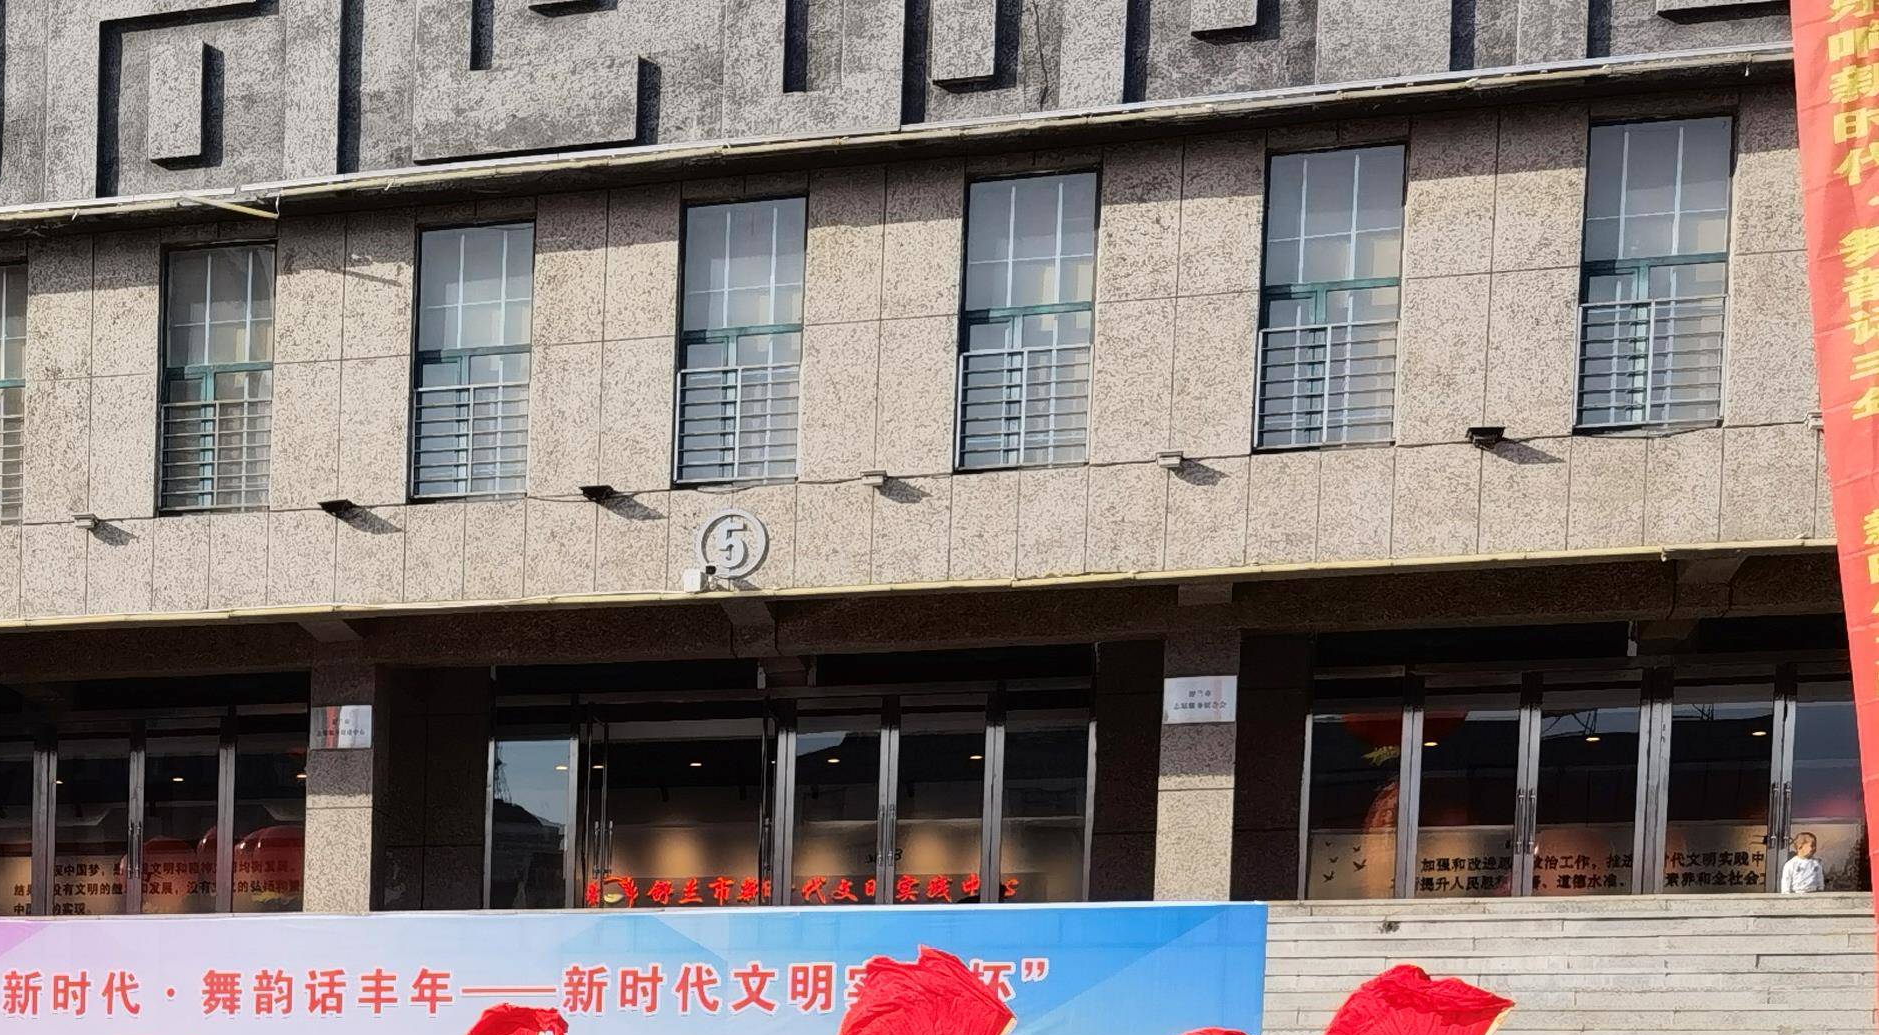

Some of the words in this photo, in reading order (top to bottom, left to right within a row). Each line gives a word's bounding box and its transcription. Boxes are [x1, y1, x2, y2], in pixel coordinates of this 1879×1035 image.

[716, 516, 749, 570] 5
[647, 873, 1020, 906] 舒兰市新代文实践中
